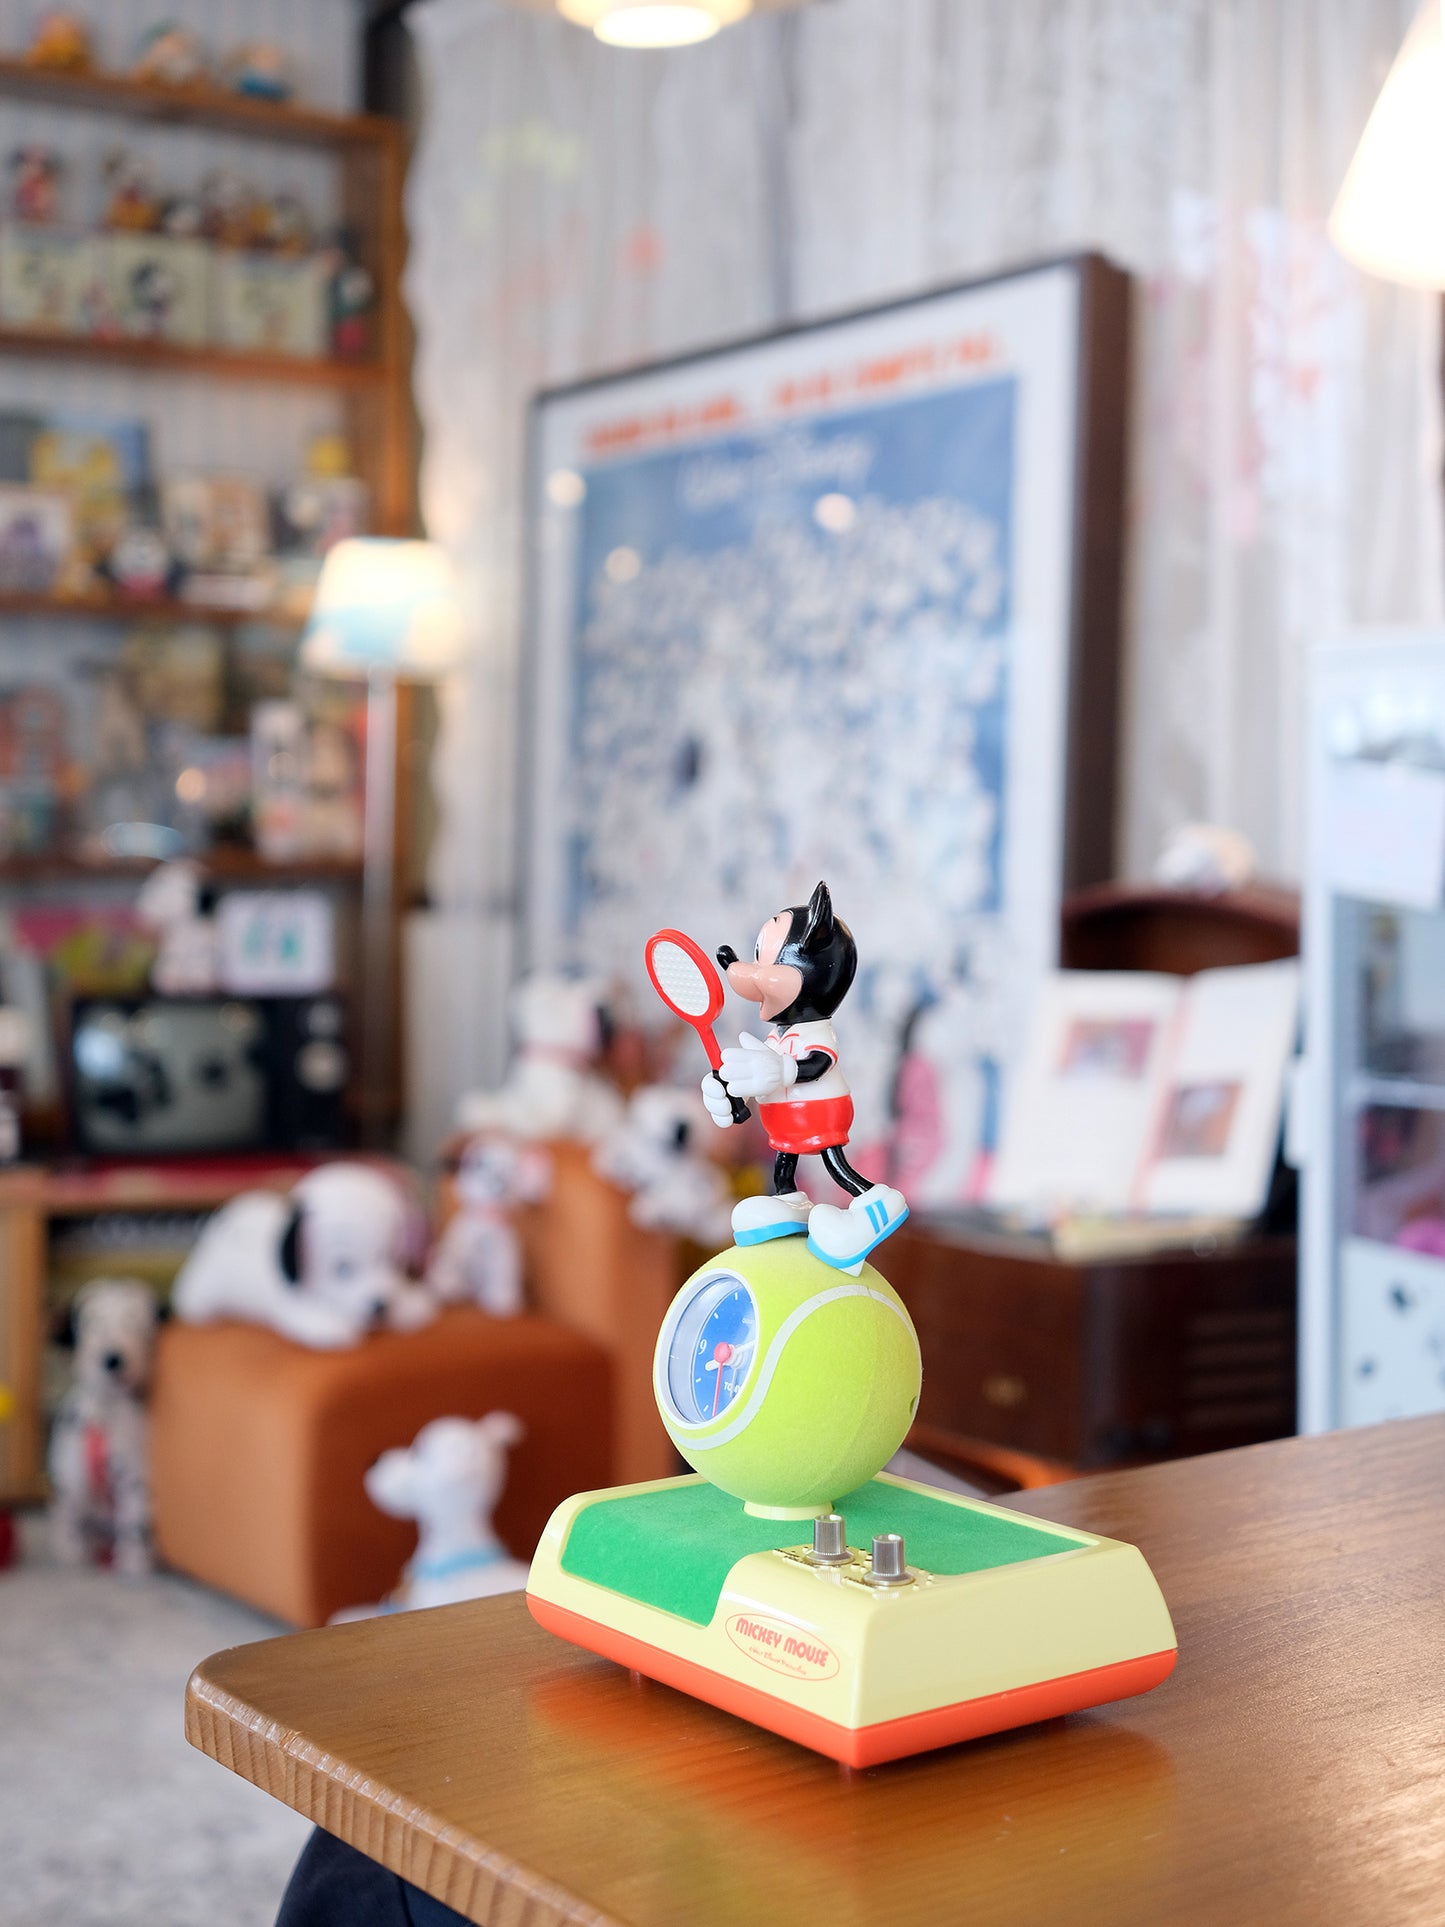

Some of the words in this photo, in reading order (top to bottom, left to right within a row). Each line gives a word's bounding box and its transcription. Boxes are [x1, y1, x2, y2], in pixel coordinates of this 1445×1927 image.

[698, 1338, 707, 1355] 9
[735, 1617, 782, 1648] MICKEY
[783, 1637, 829, 1668] MOUSE
